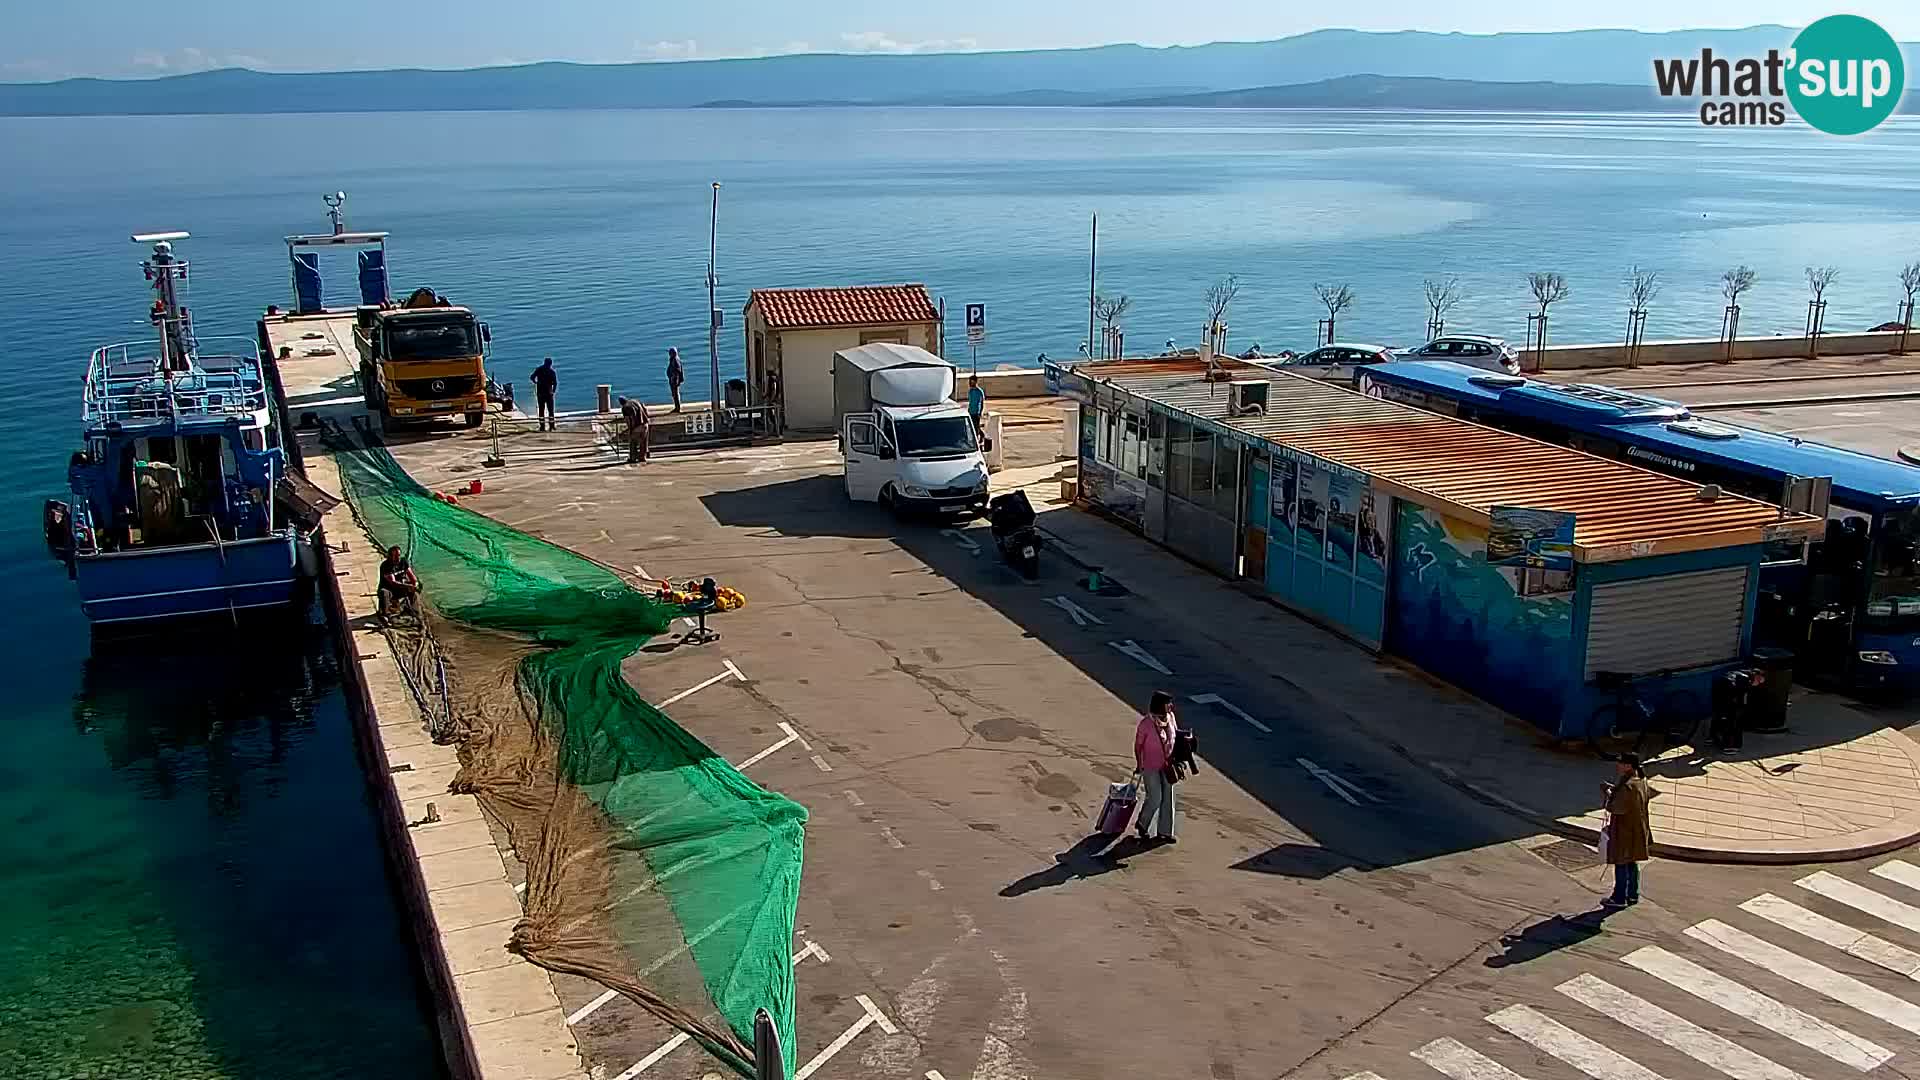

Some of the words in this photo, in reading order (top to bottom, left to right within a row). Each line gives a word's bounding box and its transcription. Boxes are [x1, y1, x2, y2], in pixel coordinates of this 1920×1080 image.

[970, 306, 981, 324] P
[1283, 449, 1312, 465] STATION
[1315, 459, 1340, 475] TICKET
